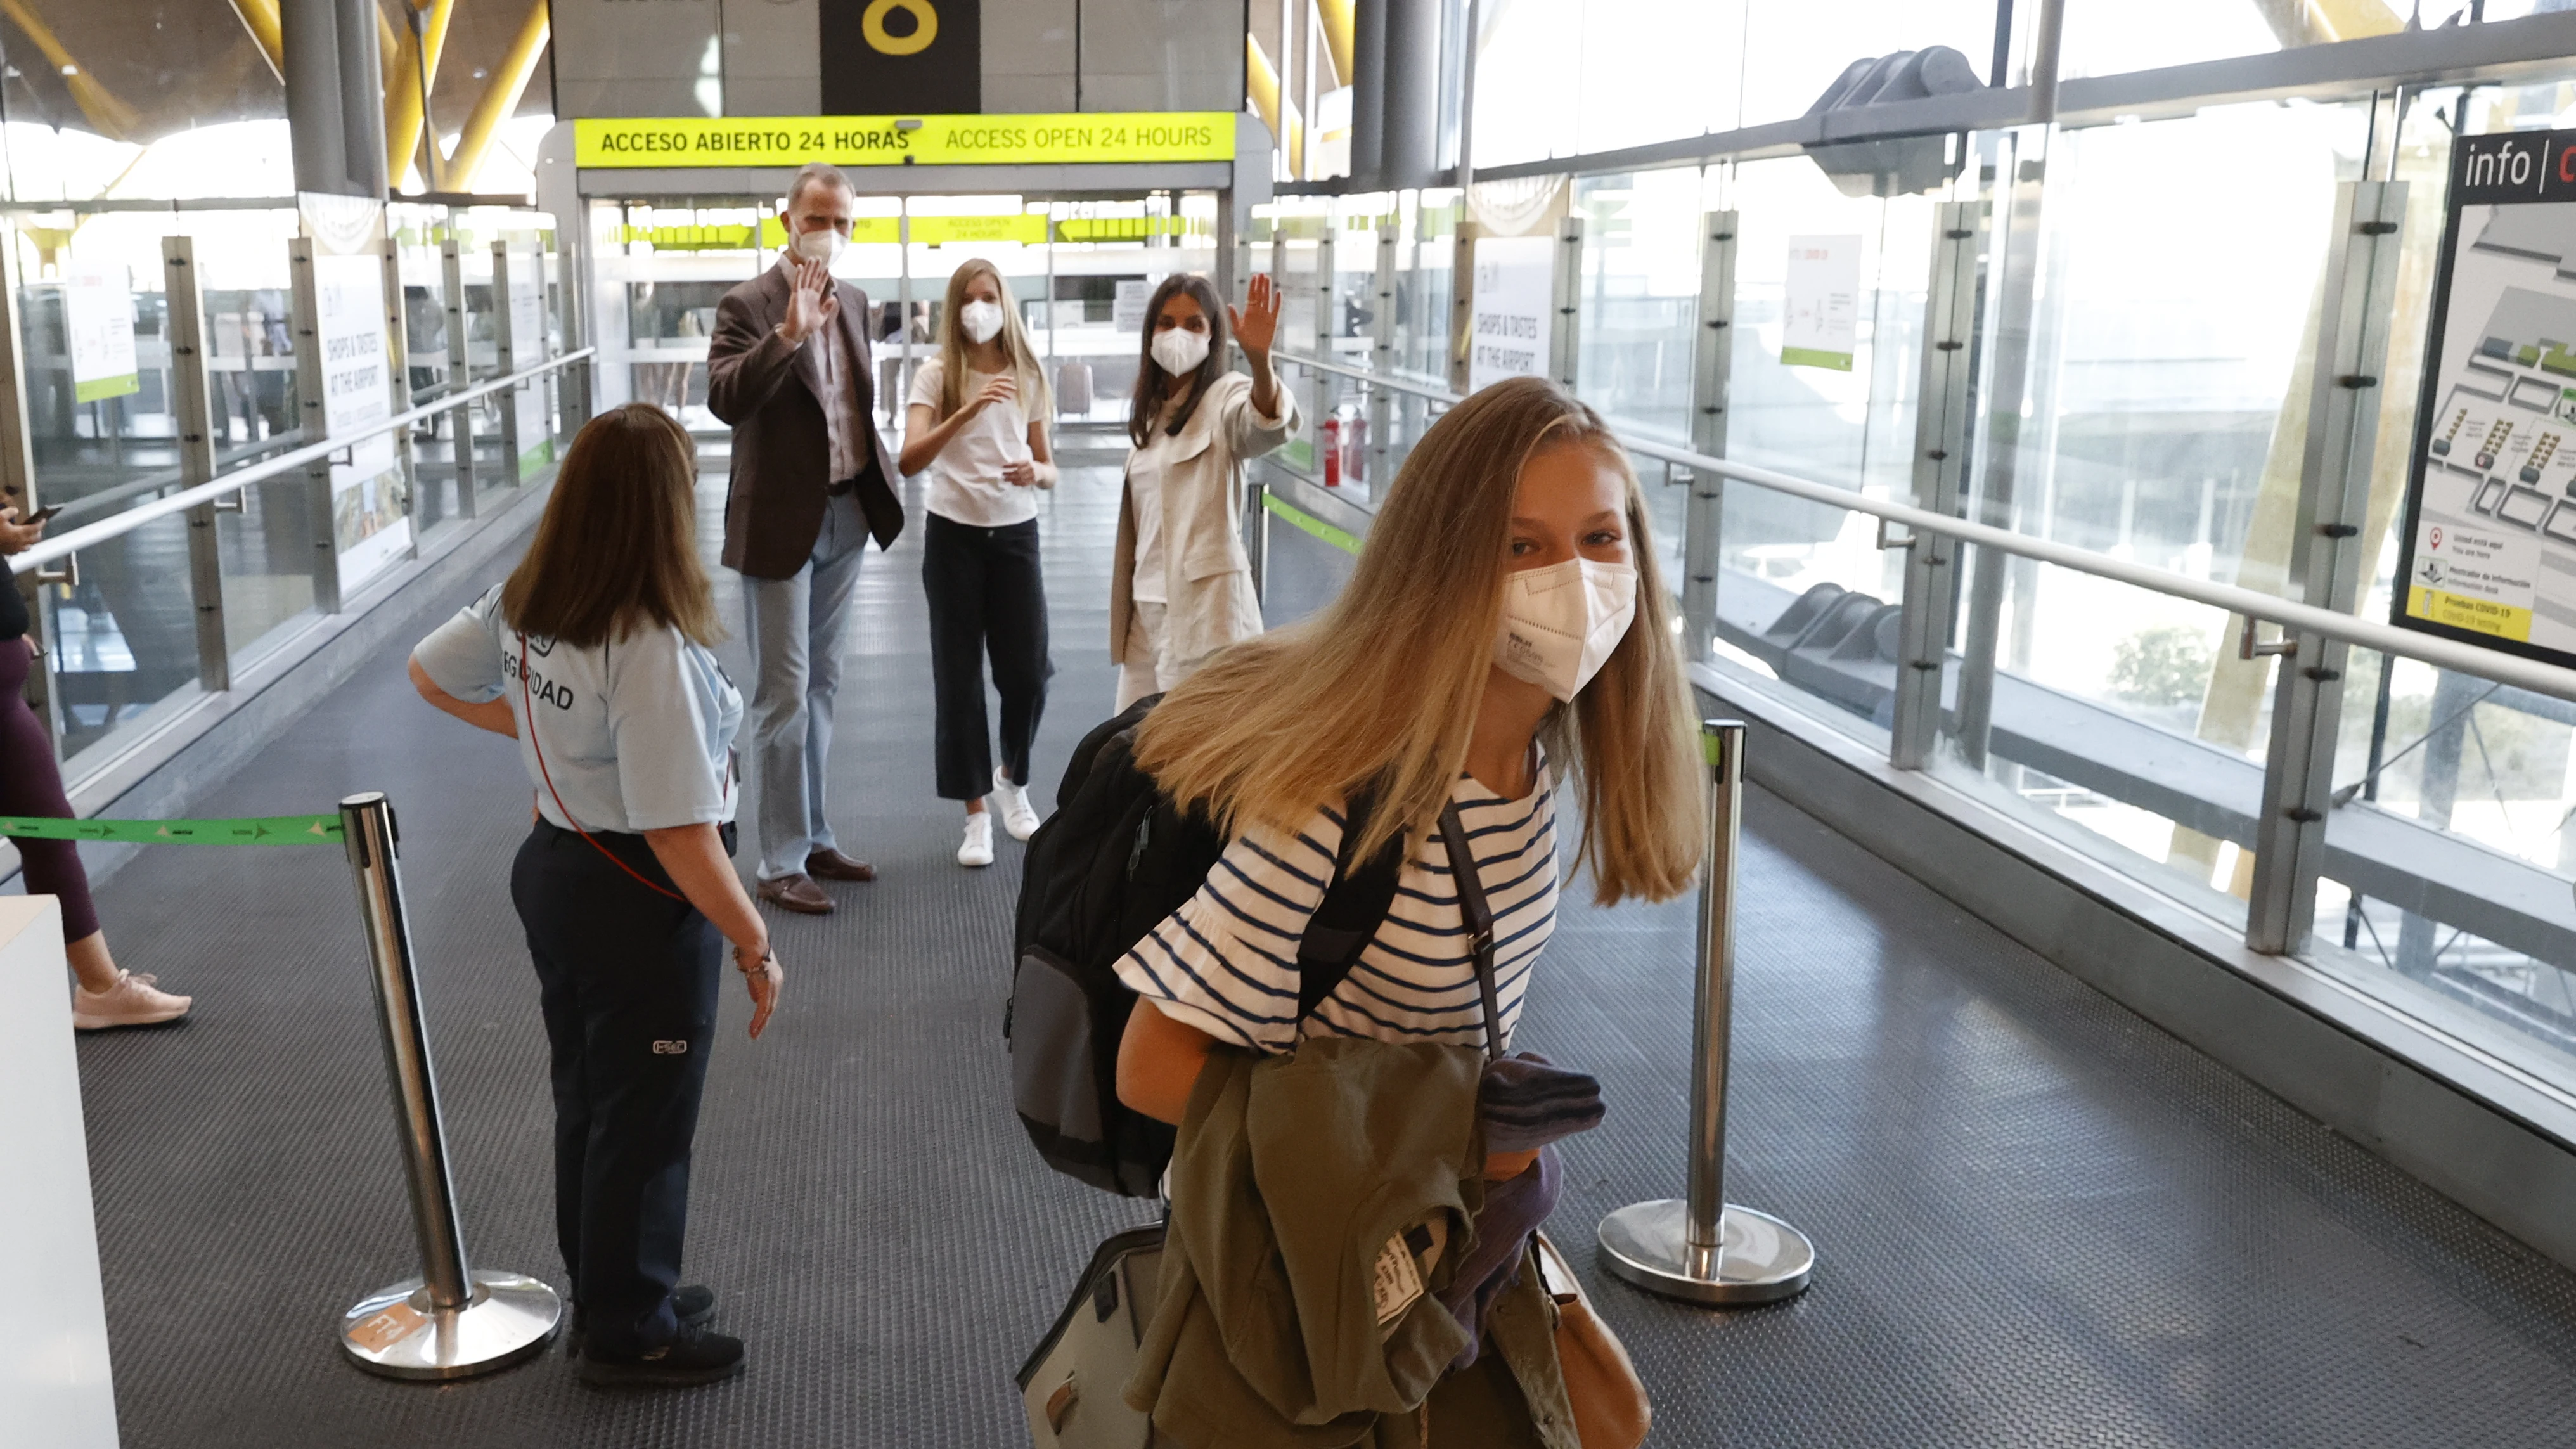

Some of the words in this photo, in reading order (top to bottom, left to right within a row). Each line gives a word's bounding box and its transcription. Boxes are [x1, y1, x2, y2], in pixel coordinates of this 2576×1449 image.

[602, 133, 687, 151] ACCESO
[696, 132, 790, 151] ABIERTO
[799, 132, 825, 150] 24
[835, 130, 908, 149] HORAS
[946, 129, 1026, 148] ACCESS
[1034, 129, 1092, 148] OPEN
[1101, 128, 1126, 146] 24
[1137, 126, 1211, 146] HOURS
[2465, 140, 2531, 186] info
[504, 650, 574, 711] EGURIDAD
